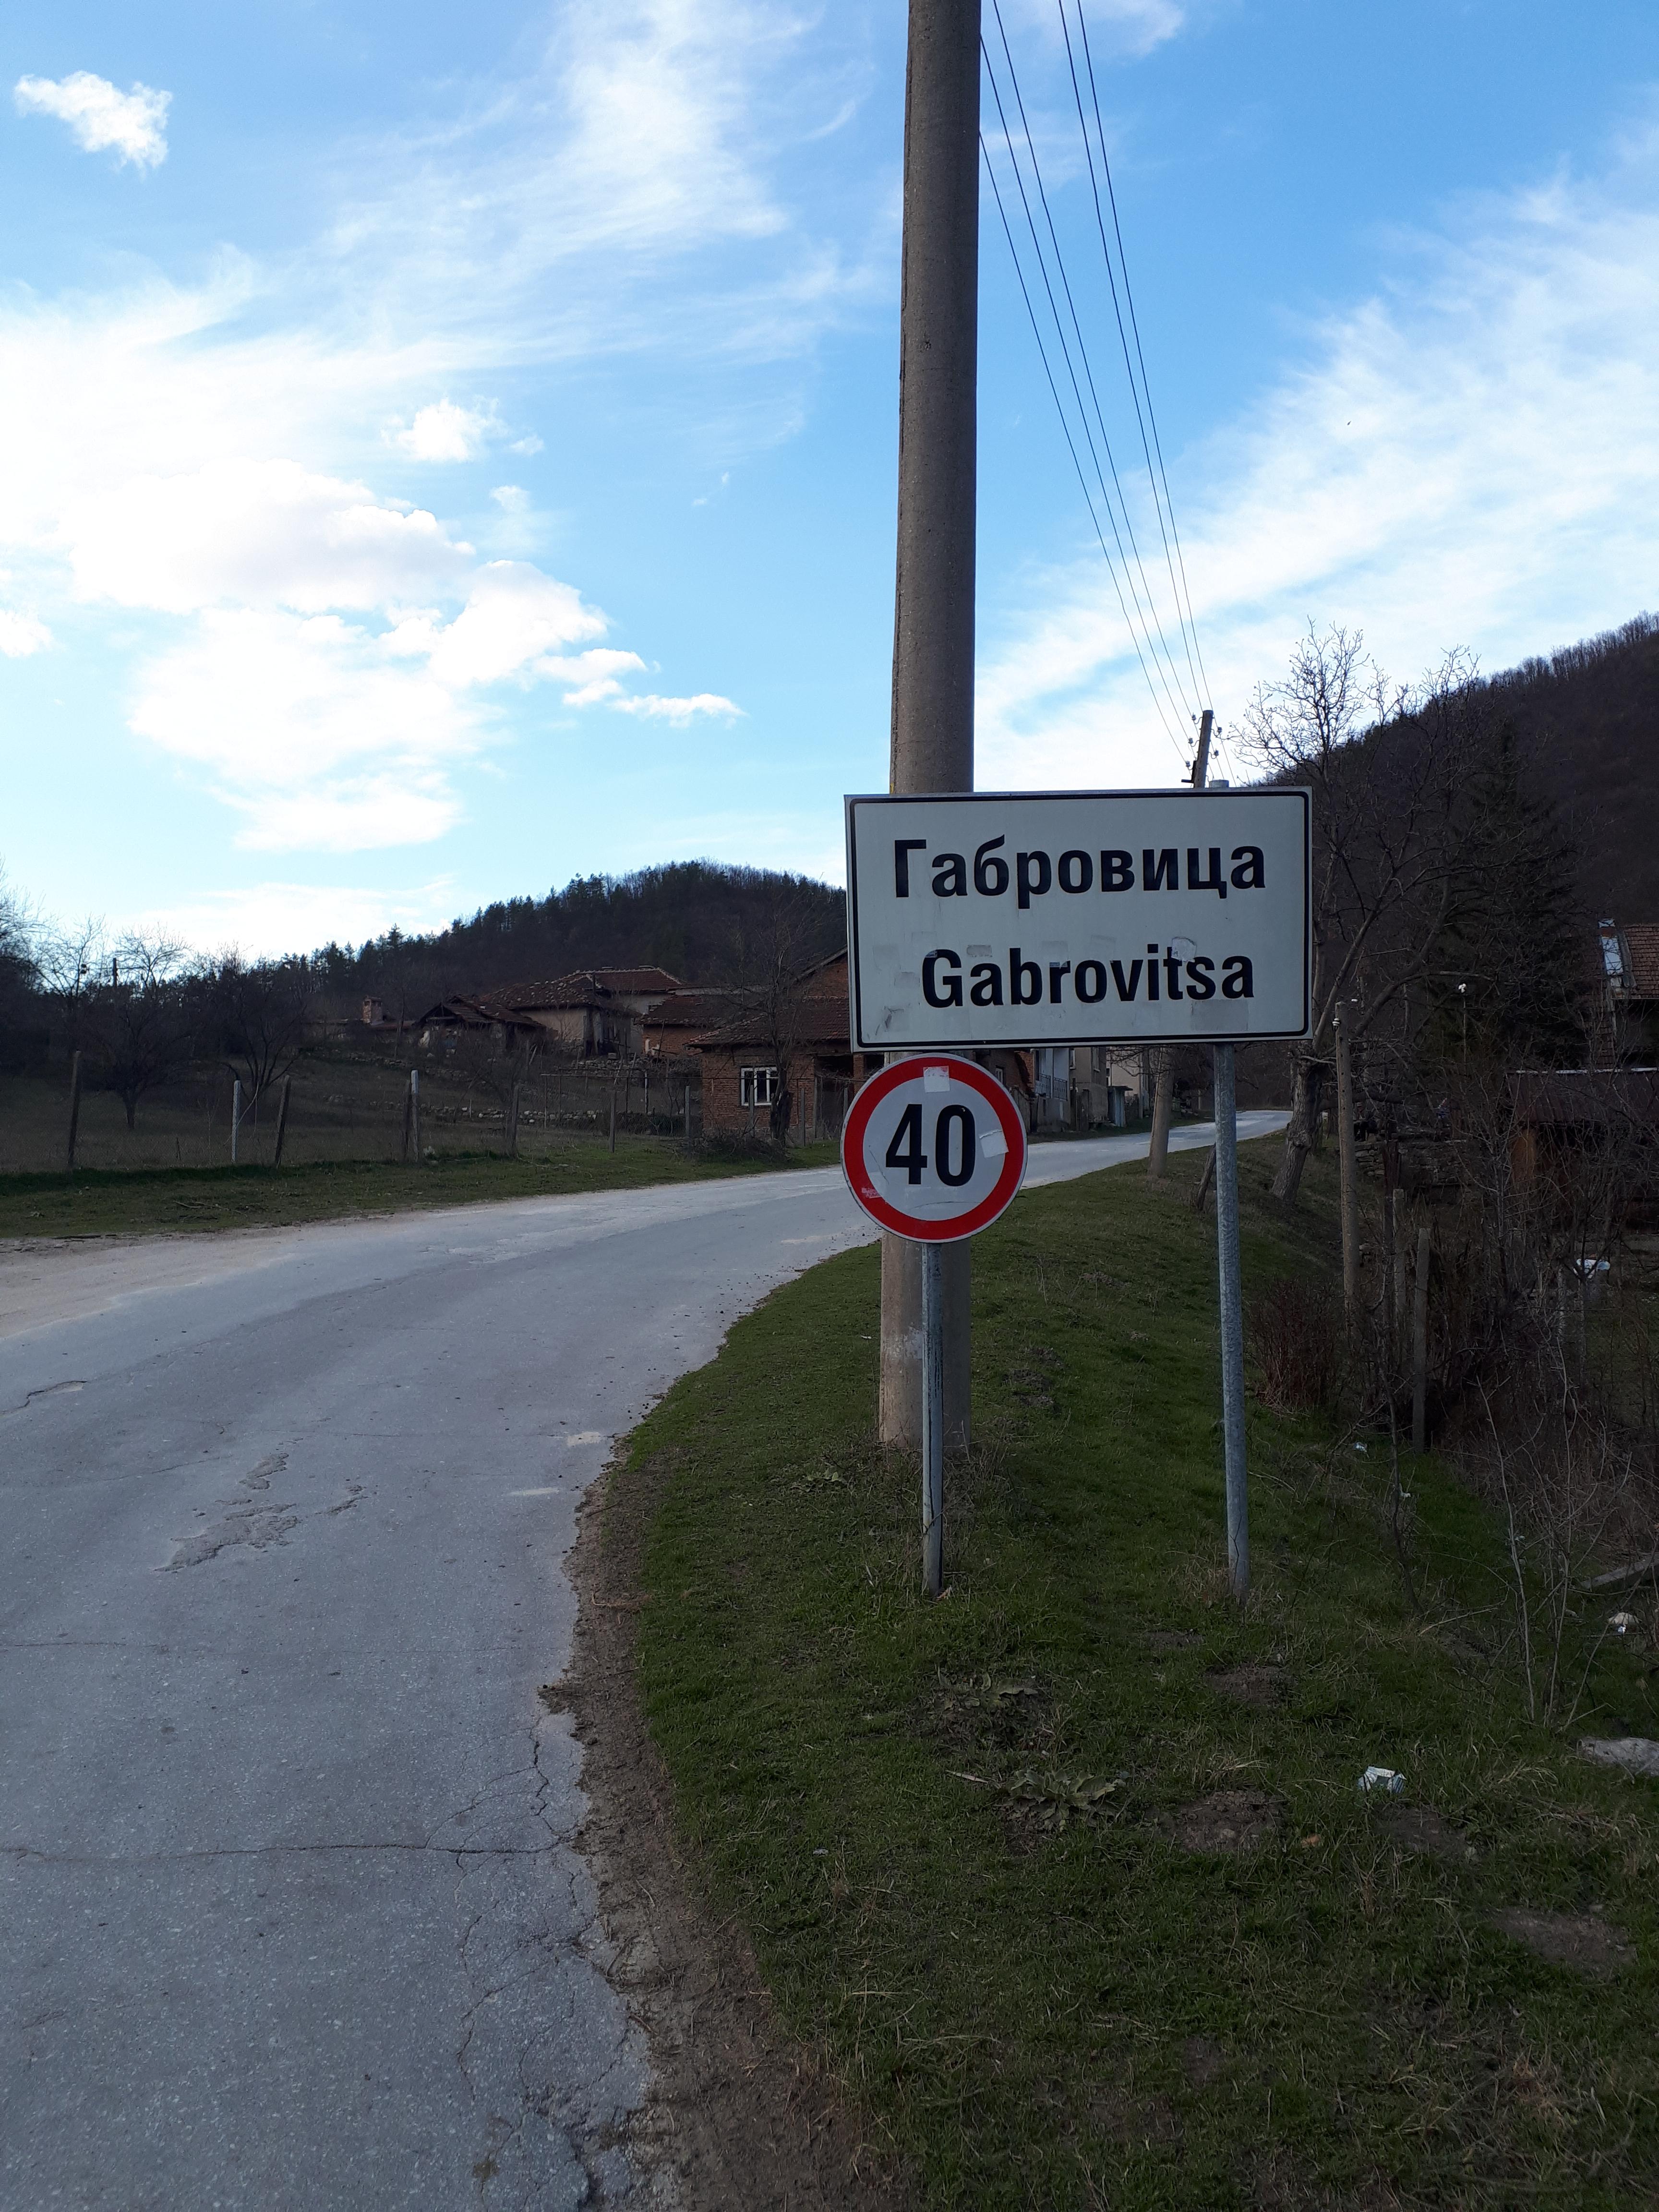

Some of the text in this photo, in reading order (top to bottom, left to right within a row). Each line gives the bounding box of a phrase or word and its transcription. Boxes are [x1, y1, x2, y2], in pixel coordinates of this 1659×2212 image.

[894, 834, 1266, 910] Габровица
[922, 943, 1254, 1008] Gabrovitsa
[886, 1104, 976, 1187] 40
